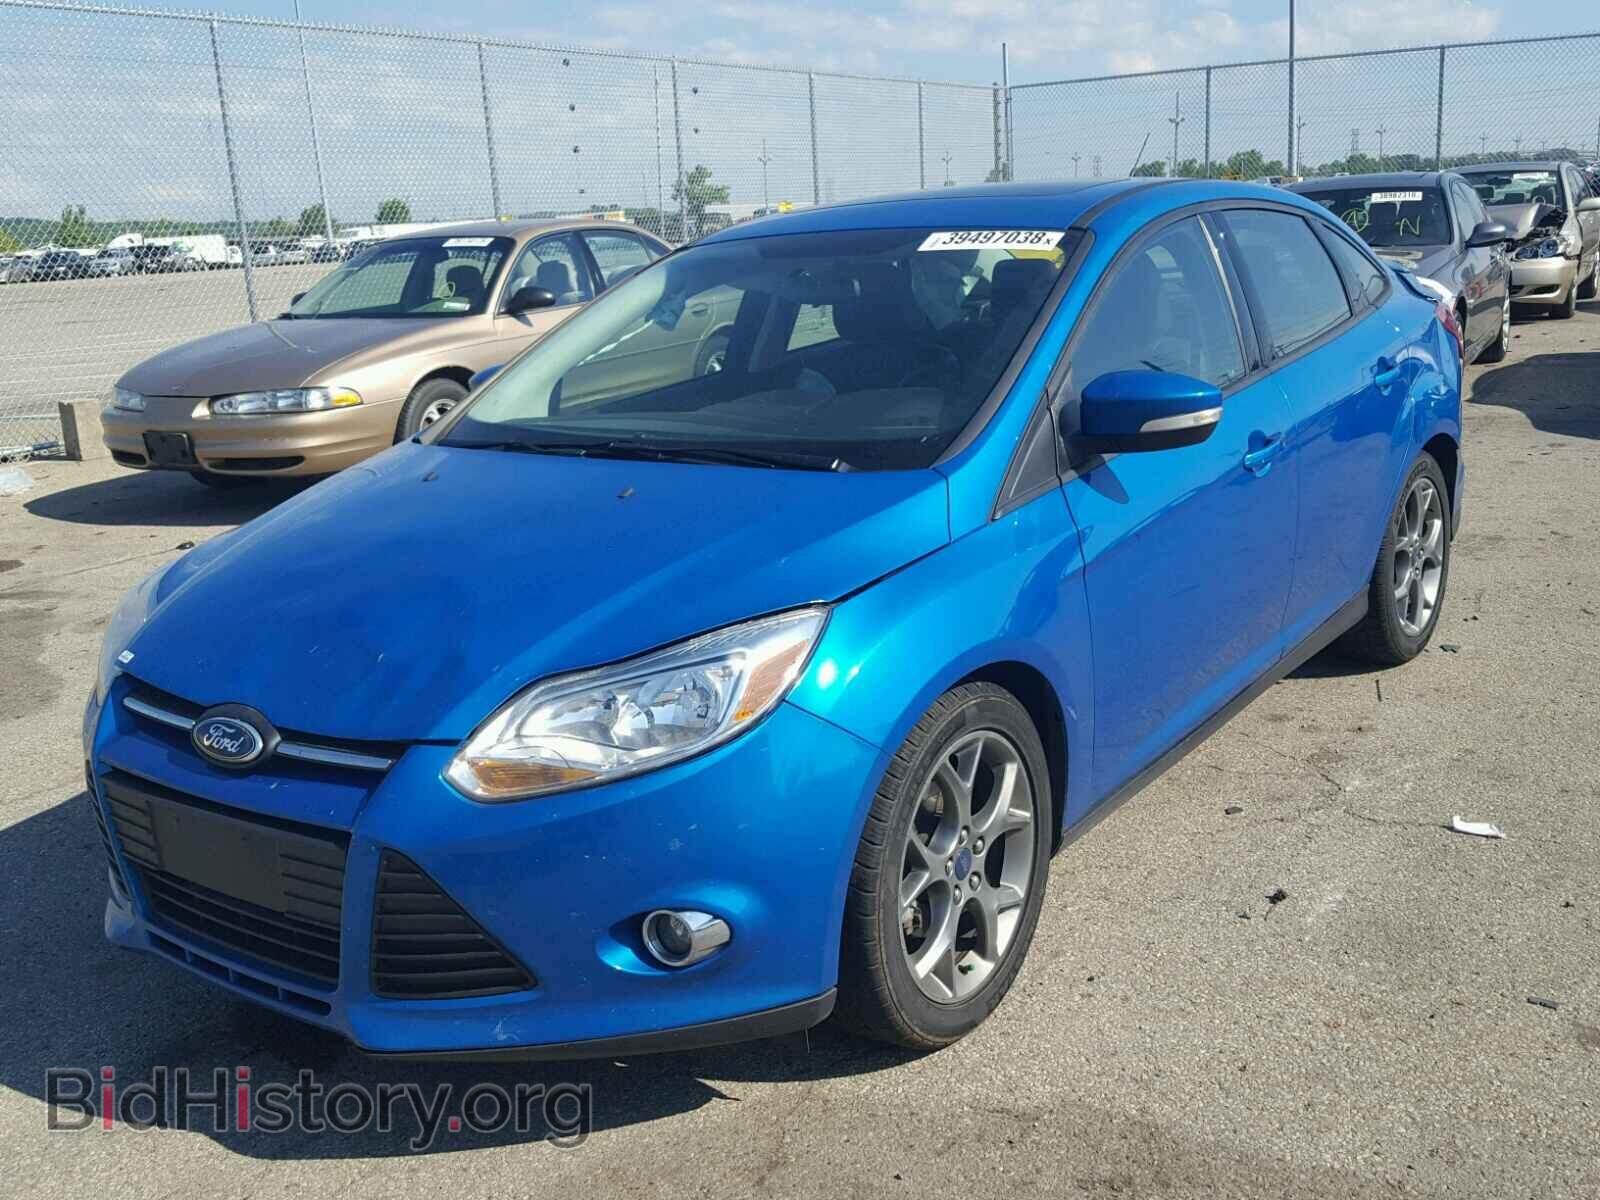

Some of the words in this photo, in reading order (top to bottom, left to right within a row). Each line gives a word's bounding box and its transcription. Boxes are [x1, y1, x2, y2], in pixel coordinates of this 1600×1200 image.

[1400, 216, 1421, 237] N
[942, 231, 1047, 245] 39497038
[203, 723, 245, 753] Ford
